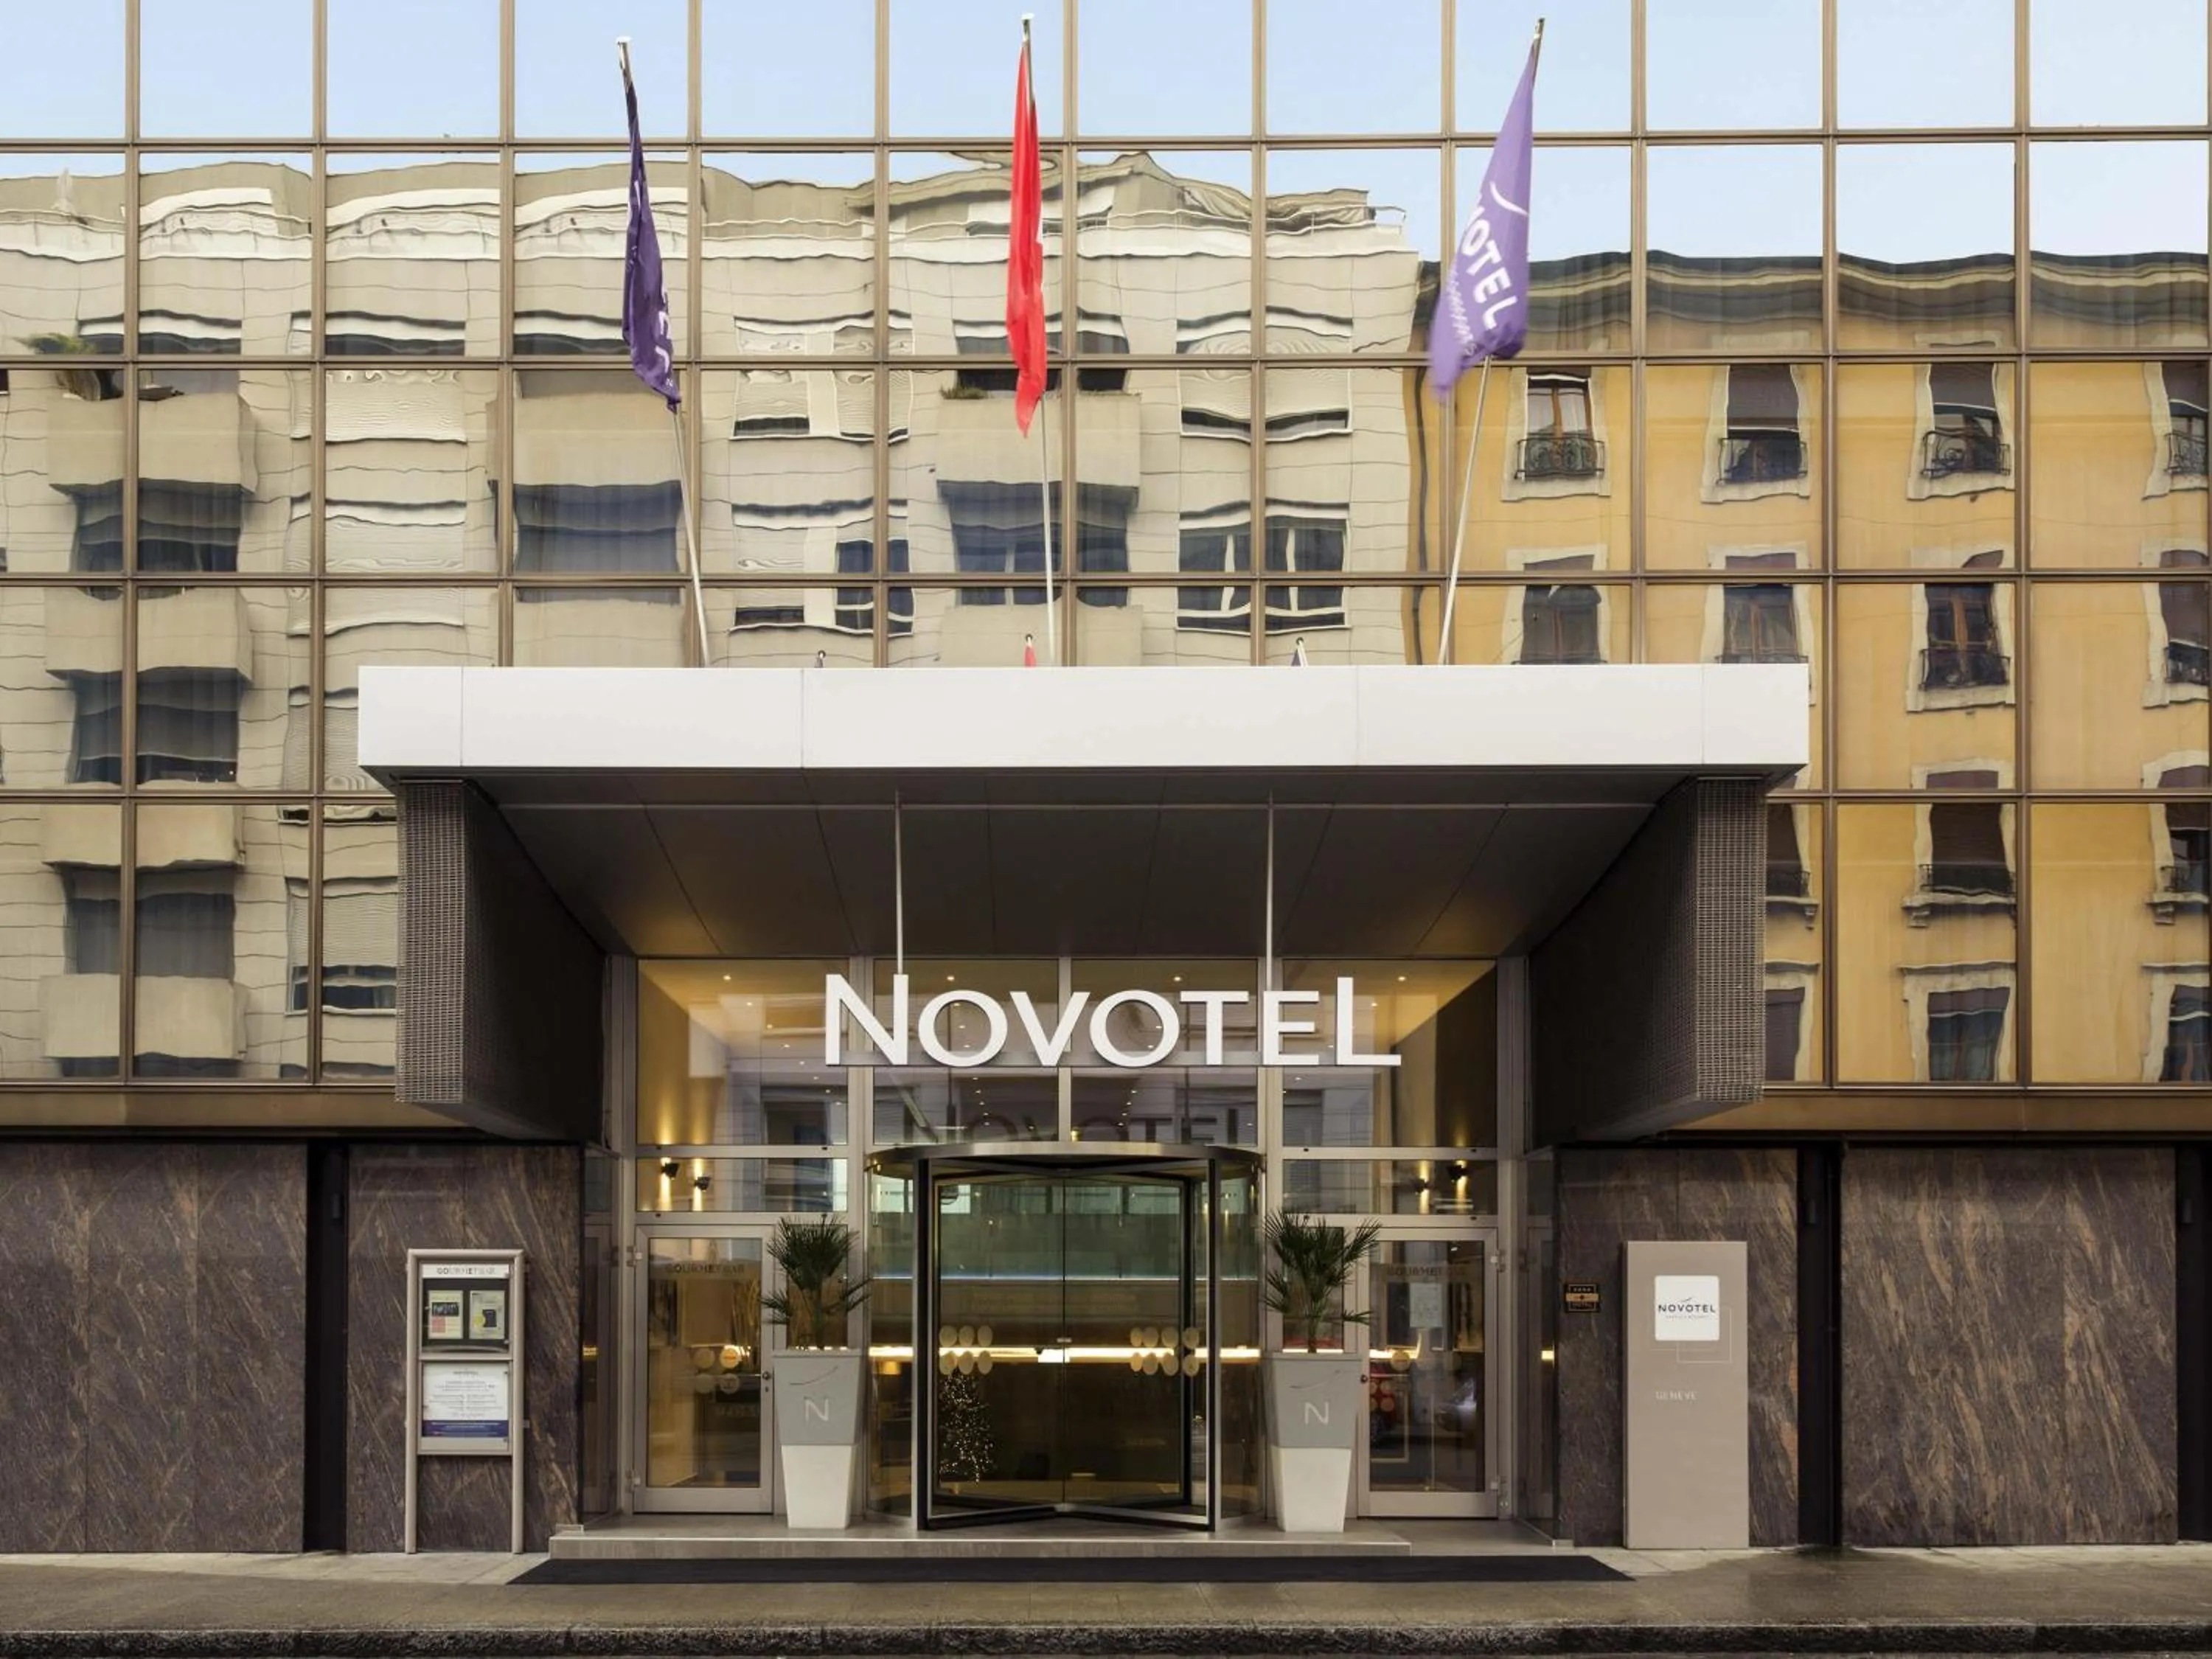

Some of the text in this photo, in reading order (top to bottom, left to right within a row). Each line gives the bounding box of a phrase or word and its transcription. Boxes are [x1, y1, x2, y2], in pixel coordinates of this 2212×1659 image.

[825, 974, 1402, 1067] NOVOTEL
[1658, 1304, 1716, 1313] NOVOTEL
[805, 1399, 829, 1422] N
[1304, 1402, 1329, 1425] N
